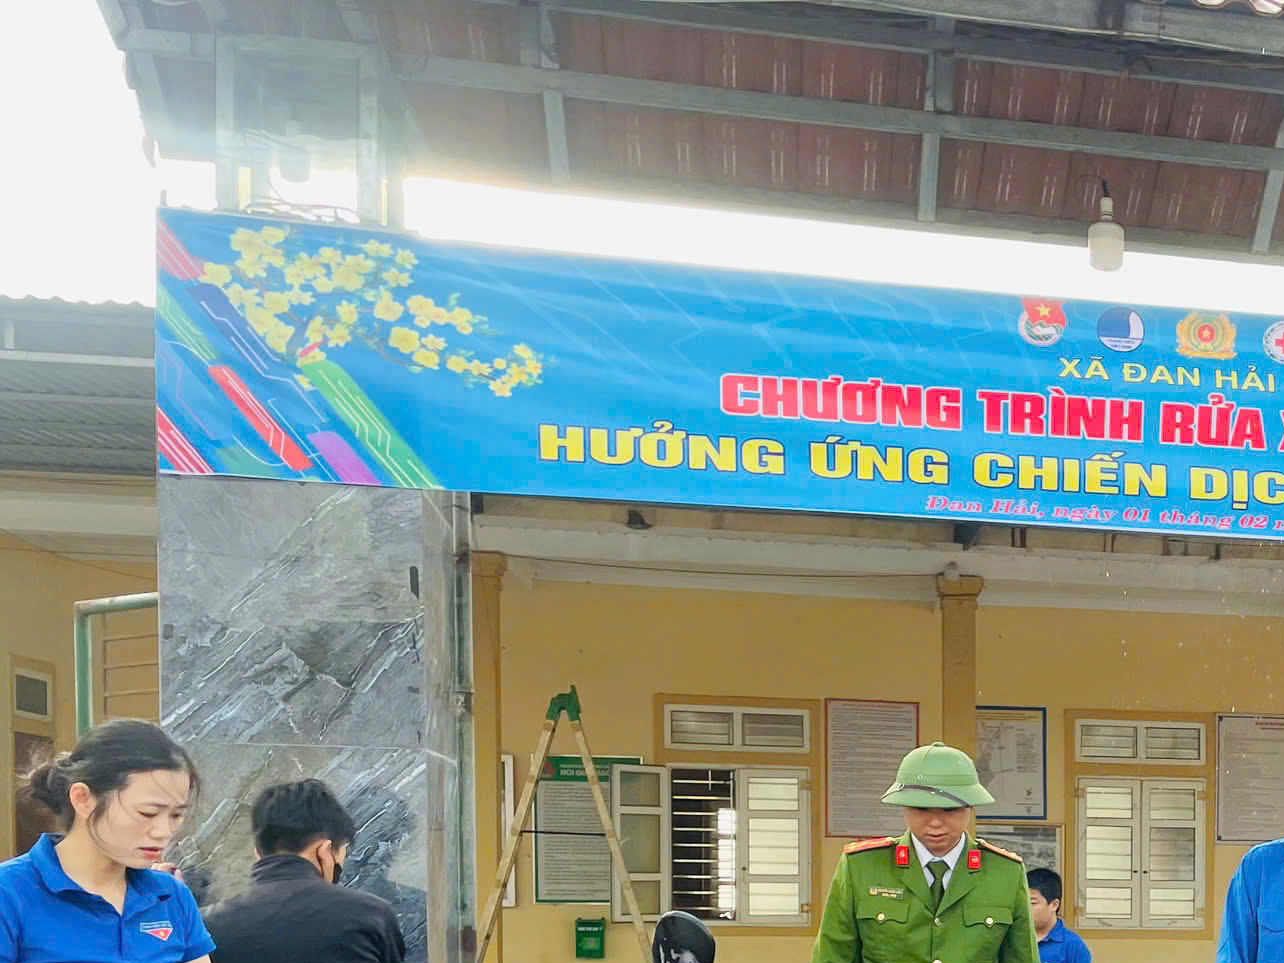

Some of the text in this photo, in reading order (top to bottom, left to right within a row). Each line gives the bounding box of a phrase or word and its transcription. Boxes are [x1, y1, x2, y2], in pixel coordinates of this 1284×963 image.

[1057, 355, 1277, 393] XÃ ĐAN HẢI
[720, 373, 963, 431] CHƯƠNG
[976, 387, 1145, 443] TRÌNH
[1160, 392, 1268, 451] RỬA
[538, 419, 786, 475] HƯỞNG
[809, 434, 950, 485] ỨNG
[972, 450, 1168, 498] CHIẾN
[925, 495, 983, 513] Đan
[989, 498, 1045, 519] Hải,
[1052, 505, 1118, 521] ngày
[1122, 506, 1151, 523] 01
[1159, 509, 1235, 529] tháng
[1239, 514, 1269, 529] 02
